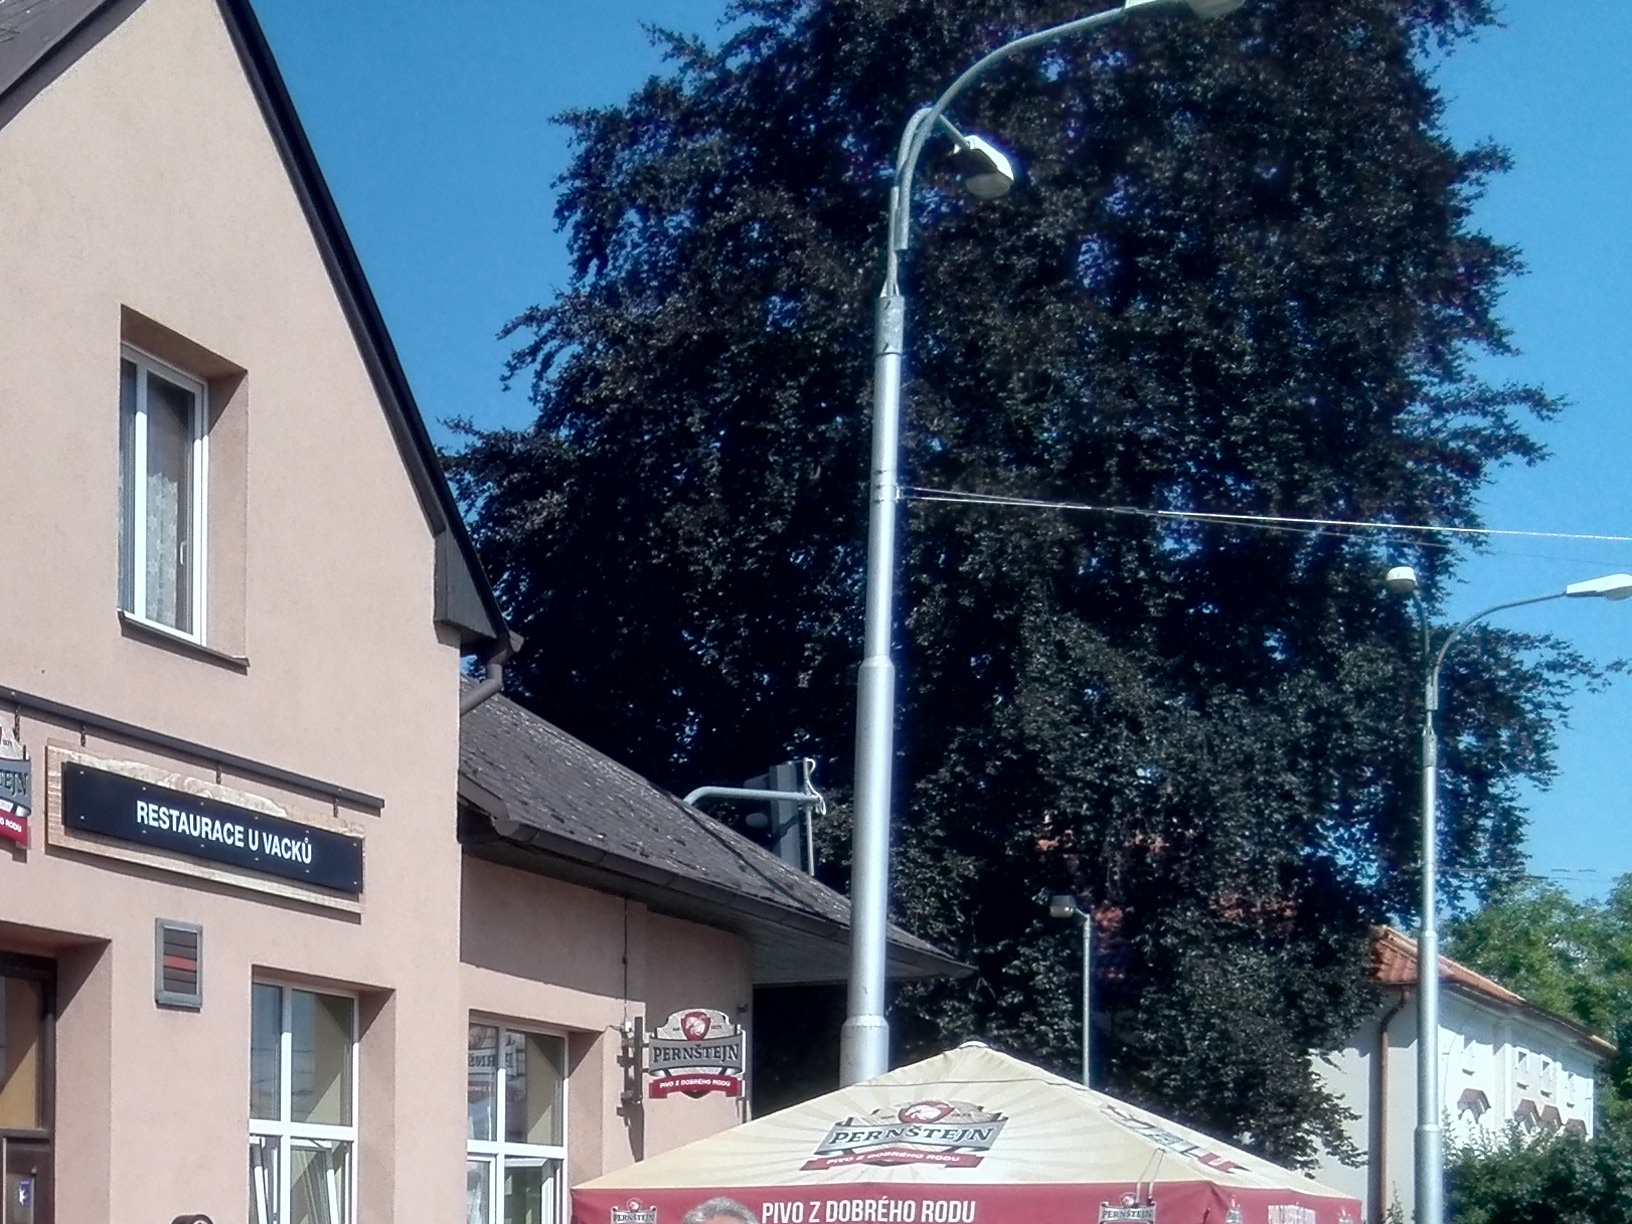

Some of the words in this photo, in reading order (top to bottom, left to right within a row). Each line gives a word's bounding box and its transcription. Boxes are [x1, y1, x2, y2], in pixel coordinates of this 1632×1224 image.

[136, 800, 245, 848] RESTAURACE
[248, 828, 260, 851] U
[262, 832, 312, 864] VACKŮ
[652, 1043, 739, 1063] PERNŠTEJN
[828, 1125, 996, 1145] PERNŠTEJN
[826, 1155, 854, 1164] PIVO
[926, 1153, 961, 1162] RODU
[762, 1201, 804, 1224] PIVO
[809, 1202, 821, 1223] Z
[825, 1196, 916, 1223] DOBRÉHO
[920, 1200, 976, 1223] RODU
